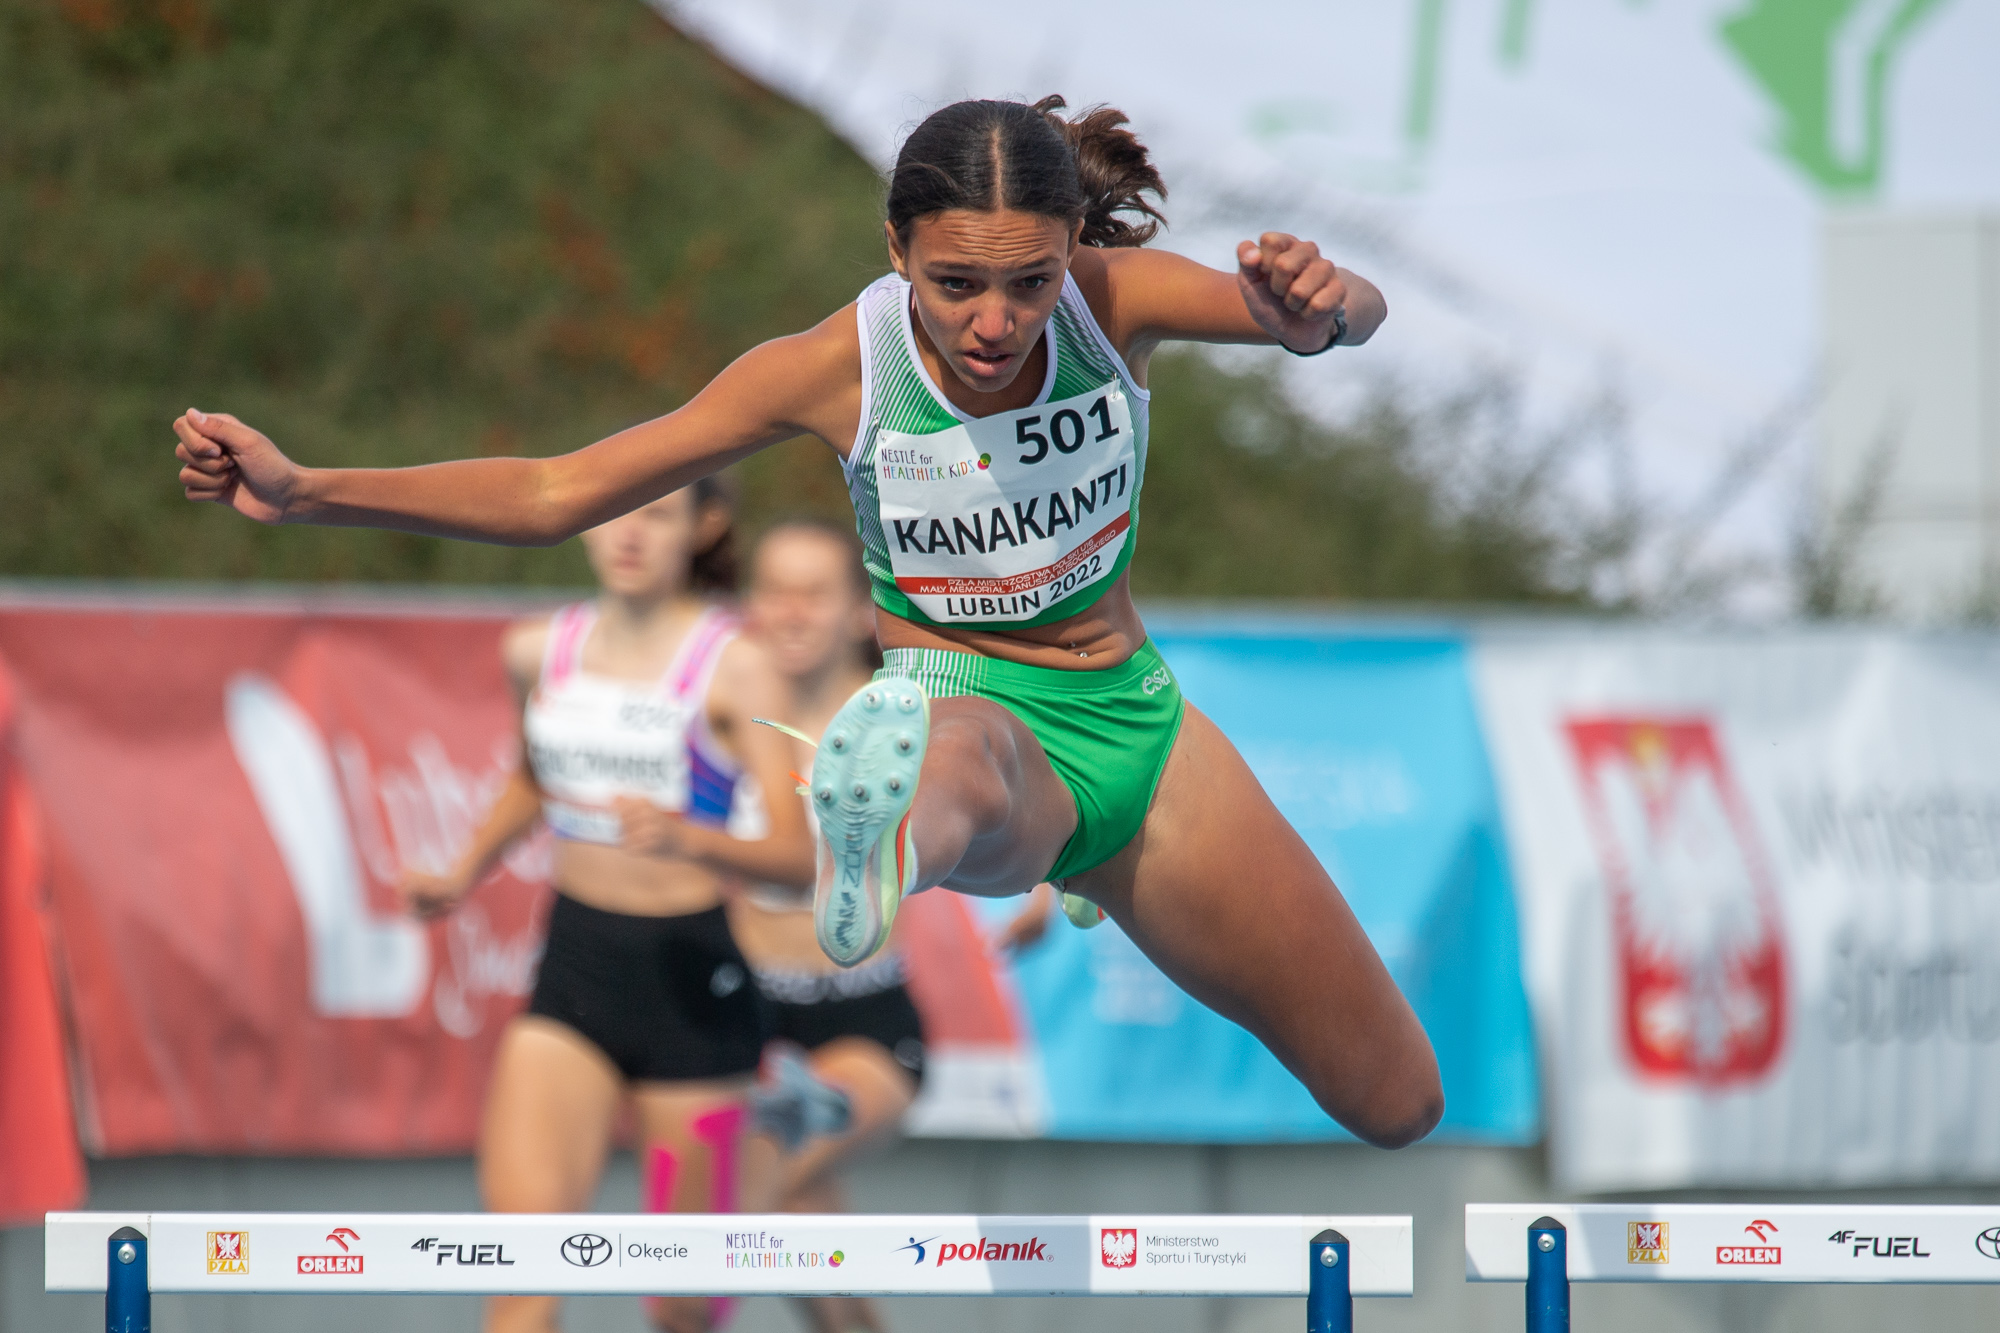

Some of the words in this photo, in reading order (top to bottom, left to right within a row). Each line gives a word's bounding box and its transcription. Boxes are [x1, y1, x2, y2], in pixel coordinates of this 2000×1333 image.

[1016, 395, 1120, 466] 501
[919, 454, 934, 465] for
[883, 465, 946, 481] HEALTHIER
[948, 459, 976, 479] KIDS
[892, 463, 1127, 556] KANAKANTI
[947, 579, 976, 587] PZLA
[977, 567, 1052, 587] MISTRZOSTWA
[1052, 549, 1080, 573] POLSKI
[946, 590, 1041, 617] LUBLIN
[1049, 554, 1103, 603] 2022
[1008, 573, 1056, 593] JANUSZA
[770, 1236, 785, 1249] for
[1146, 1235, 1219, 1248] Ministerstwo
[1852, 1237, 1932, 1258] FUEL
[436, 1244, 516, 1266] FUEL
[627, 1243, 689, 1262] Okęcie
[726, 1252, 793, 1269] HEALTHIER
[798, 1252, 825, 1268] KIDS
[936, 1236, 1048, 1268] polanik
[1146, 1252, 1185, 1266] Sportu
[1194, 1252, 1247, 1266] Turystyki
[1630, 1250, 1667, 1262] PZLA
[1719, 1248, 1778, 1263] ORLEN
[209, 1260, 247, 1273] PZLA
[300, 1257, 360, 1272] ORLEN
